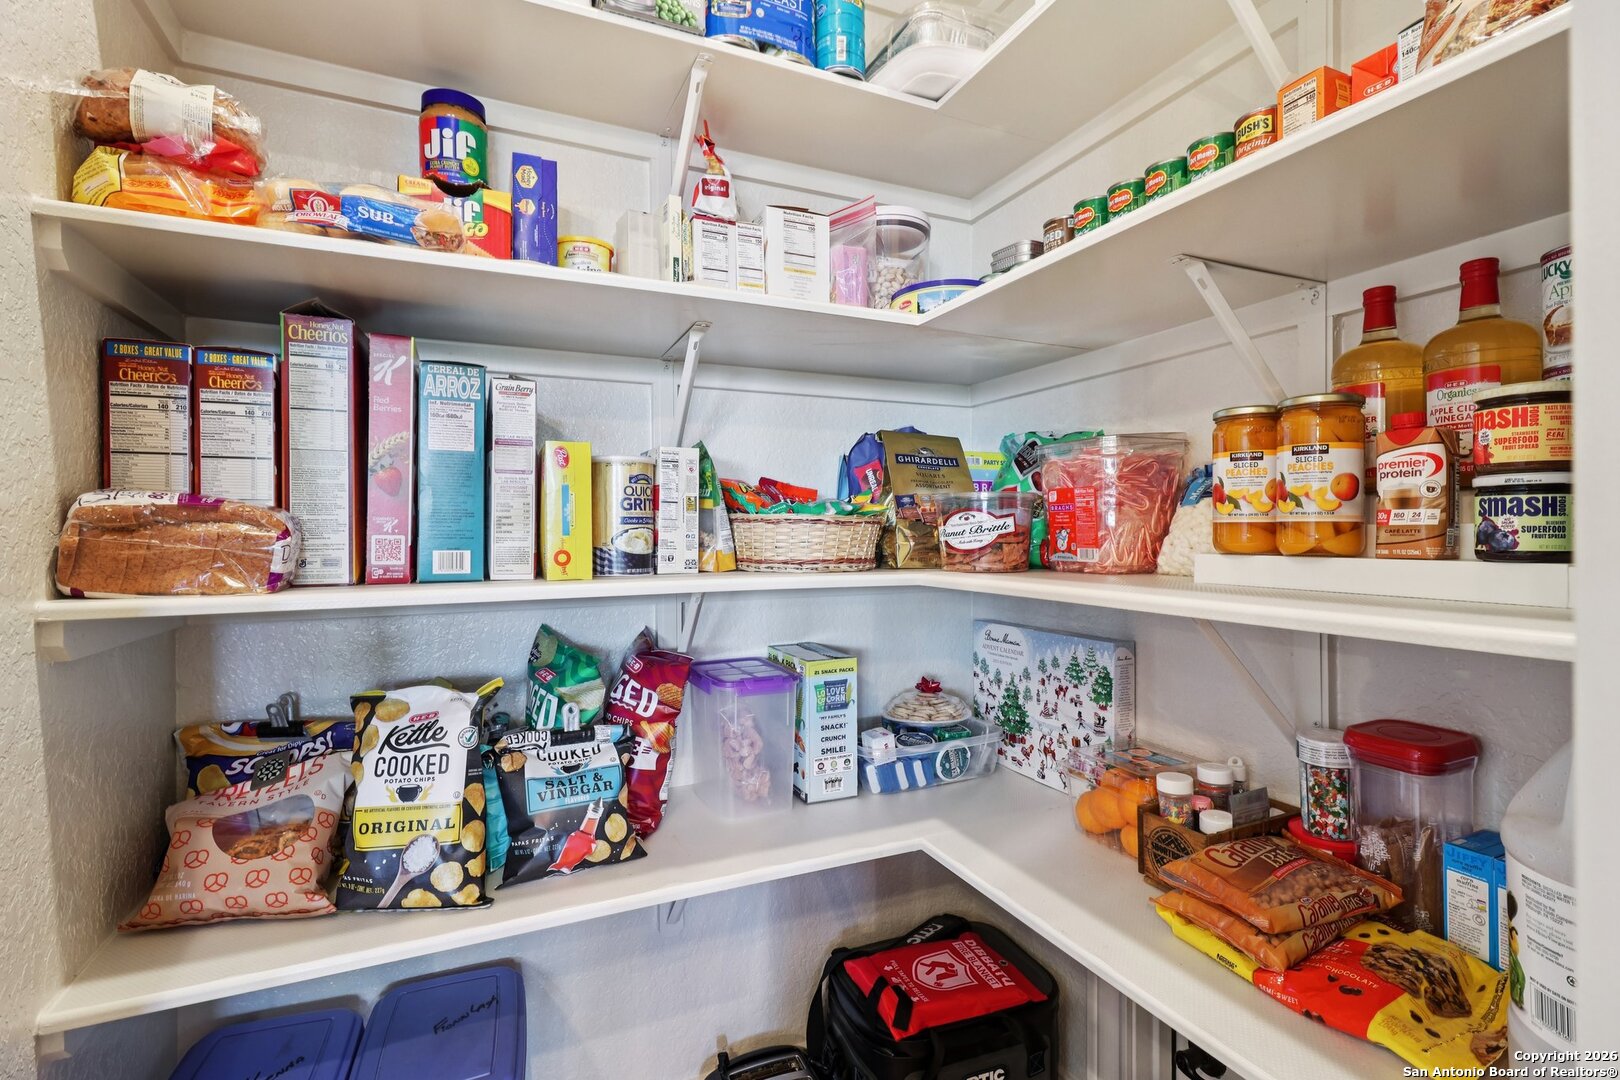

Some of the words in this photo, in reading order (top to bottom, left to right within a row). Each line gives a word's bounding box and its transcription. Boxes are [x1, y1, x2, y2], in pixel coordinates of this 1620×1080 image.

[1236, 117, 1270, 141] BUSH'S
[424, 128, 476, 160] Jif
[1236, 137, 1272, 157] Original
[357, 205, 394, 225] SUB
[309, 320, 332, 330] Honey
[332, 322, 345, 331] Nut
[288, 323, 348, 343] Cheerios
[114, 344, 118, 354] 2
[120, 344, 138, 355] BOXES
[144, 346, 163, 357] GREAT
[164, 348, 183, 358] VALUE
[204, 352, 208, 362] 2
[210, 353, 227, 364] BOXES
[232, 354, 250, 365] GREAT
[251, 356, 268, 366] VALUE
[428, 364, 465, 375] CEREAL
[467, 368, 480, 377] DE
[424, 374, 480, 400] ARROZ
[496, 382, 514, 392] Grain
[516, 385, 534, 395] Berry
[374, 395, 390, 404] Red
[374, 402, 402, 413] Berries
[1430, 405, 1456, 417] APPLE
[1494, 436, 1539, 446] SUPERFOOD
[898, 456, 958, 466] GHIRARDELLI
[1288, 462, 1334, 472] PEACHES
[1296, 456, 1324, 464] SLICED
[1378, 458, 1428, 474] premier
[1226, 468, 1268, 476] PEACHES
[1380, 468, 1422, 482] protein
[866, 468, 876, 494] UNREAL
[1558, 496, 1566, 517] FOODS
[968, 522, 1011, 536] Brittle
[982, 644, 999, 652] ADVENT
[1000, 646, 1024, 656] CALENDAR
[826, 686, 845, 696] LOVE
[612, 716, 634, 726] CHIPS
[378, 719, 449, 755] Kettle
[820, 734, 846, 742] CRUNCH
[820, 746, 846, 756] SMILE!
[374, 753, 450, 778] COOKED
[545, 774, 587, 790] SALT
[592, 772, 604, 782] &
[267, 779, 310, 800] STYLE
[537, 780, 614, 802] VINEGAR
[358, 817, 456, 835] ORIGINAL
[532, 836, 554, 844] FRITAS
[1456, 879, 1479, 890] muffins
[1298, 894, 1342, 928] Caramel
[1342, 894, 1363, 912] Bits
[955, 942, 970, 957] FIRE
[967, 955, 1000, 986] BLANKET
[1324, 964, 1380, 989] CHOCOLATE
[1258, 984, 1299, 1005] SEMI-SWEET
